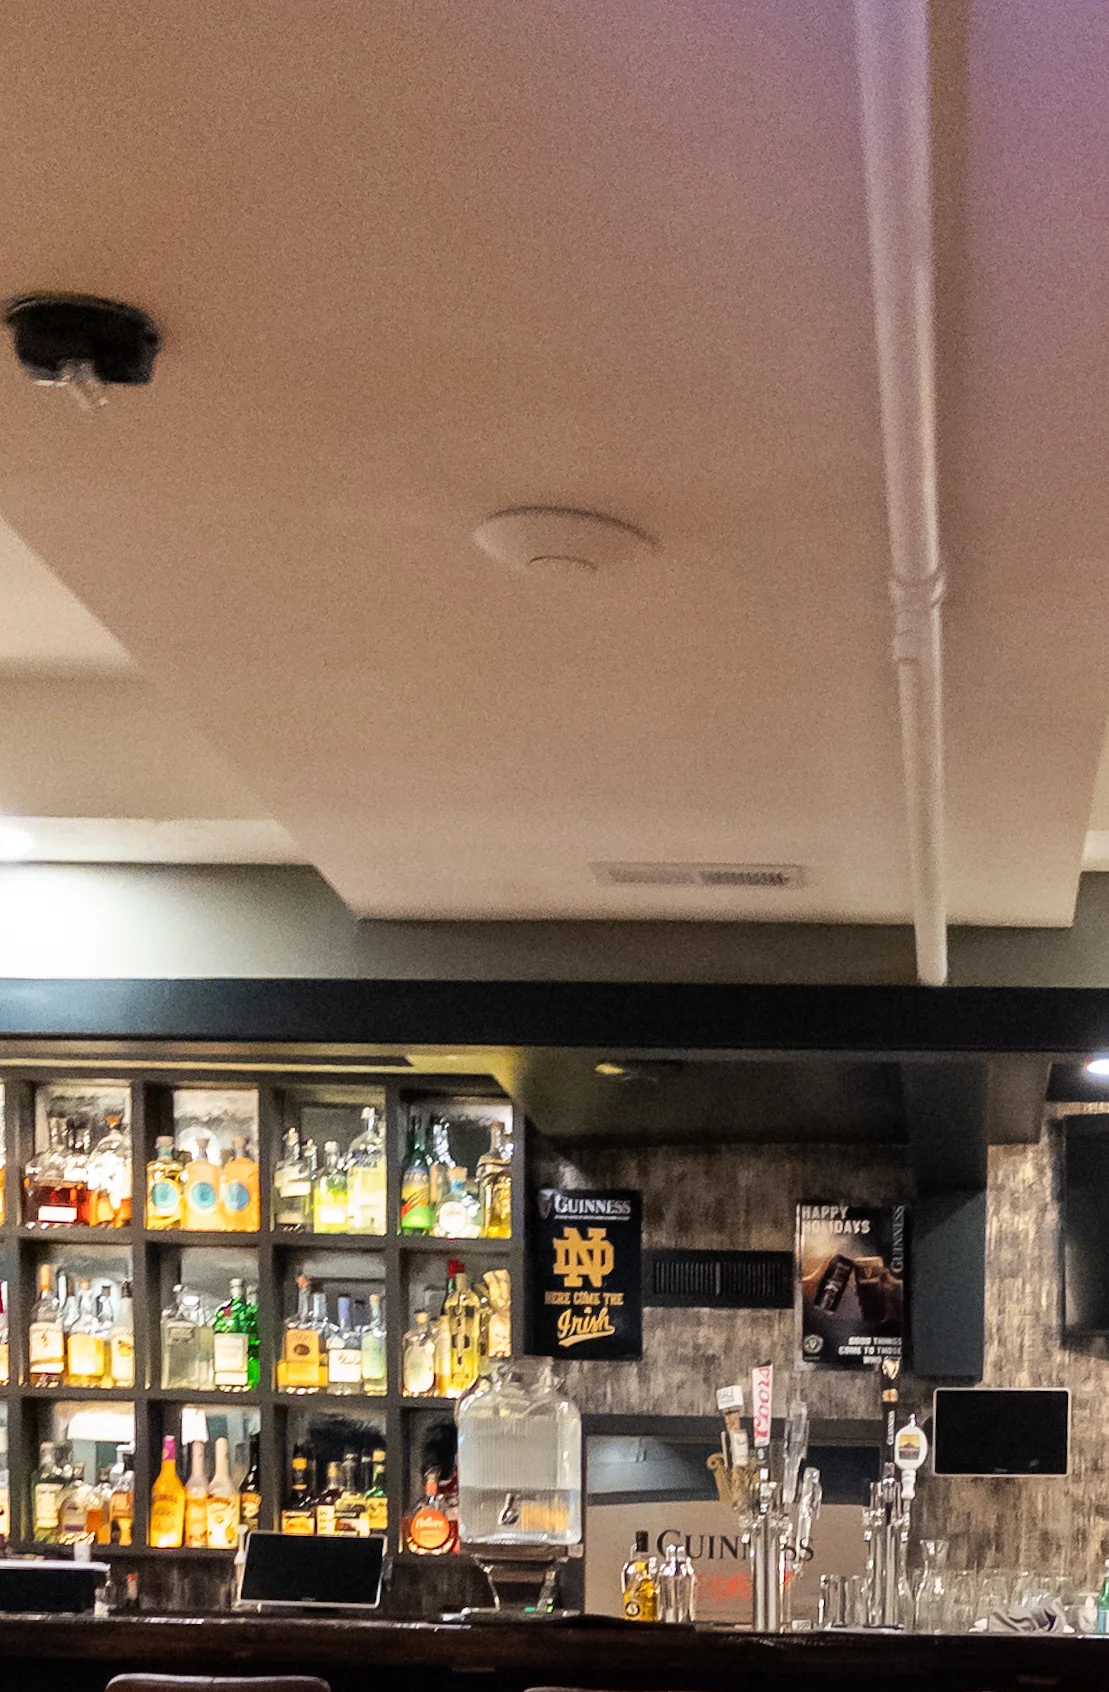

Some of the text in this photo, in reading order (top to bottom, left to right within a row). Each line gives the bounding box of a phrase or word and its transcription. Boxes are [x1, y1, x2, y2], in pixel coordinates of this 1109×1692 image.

[553, 1193, 632, 1215] GUINNESS
[802, 1205, 849, 1220] HAPPY
[802, 1219, 871, 1235] HOLIDAYS
[544, 1291, 625, 1305] HERE COME THE
[557, 1305, 615, 1341] Irish
